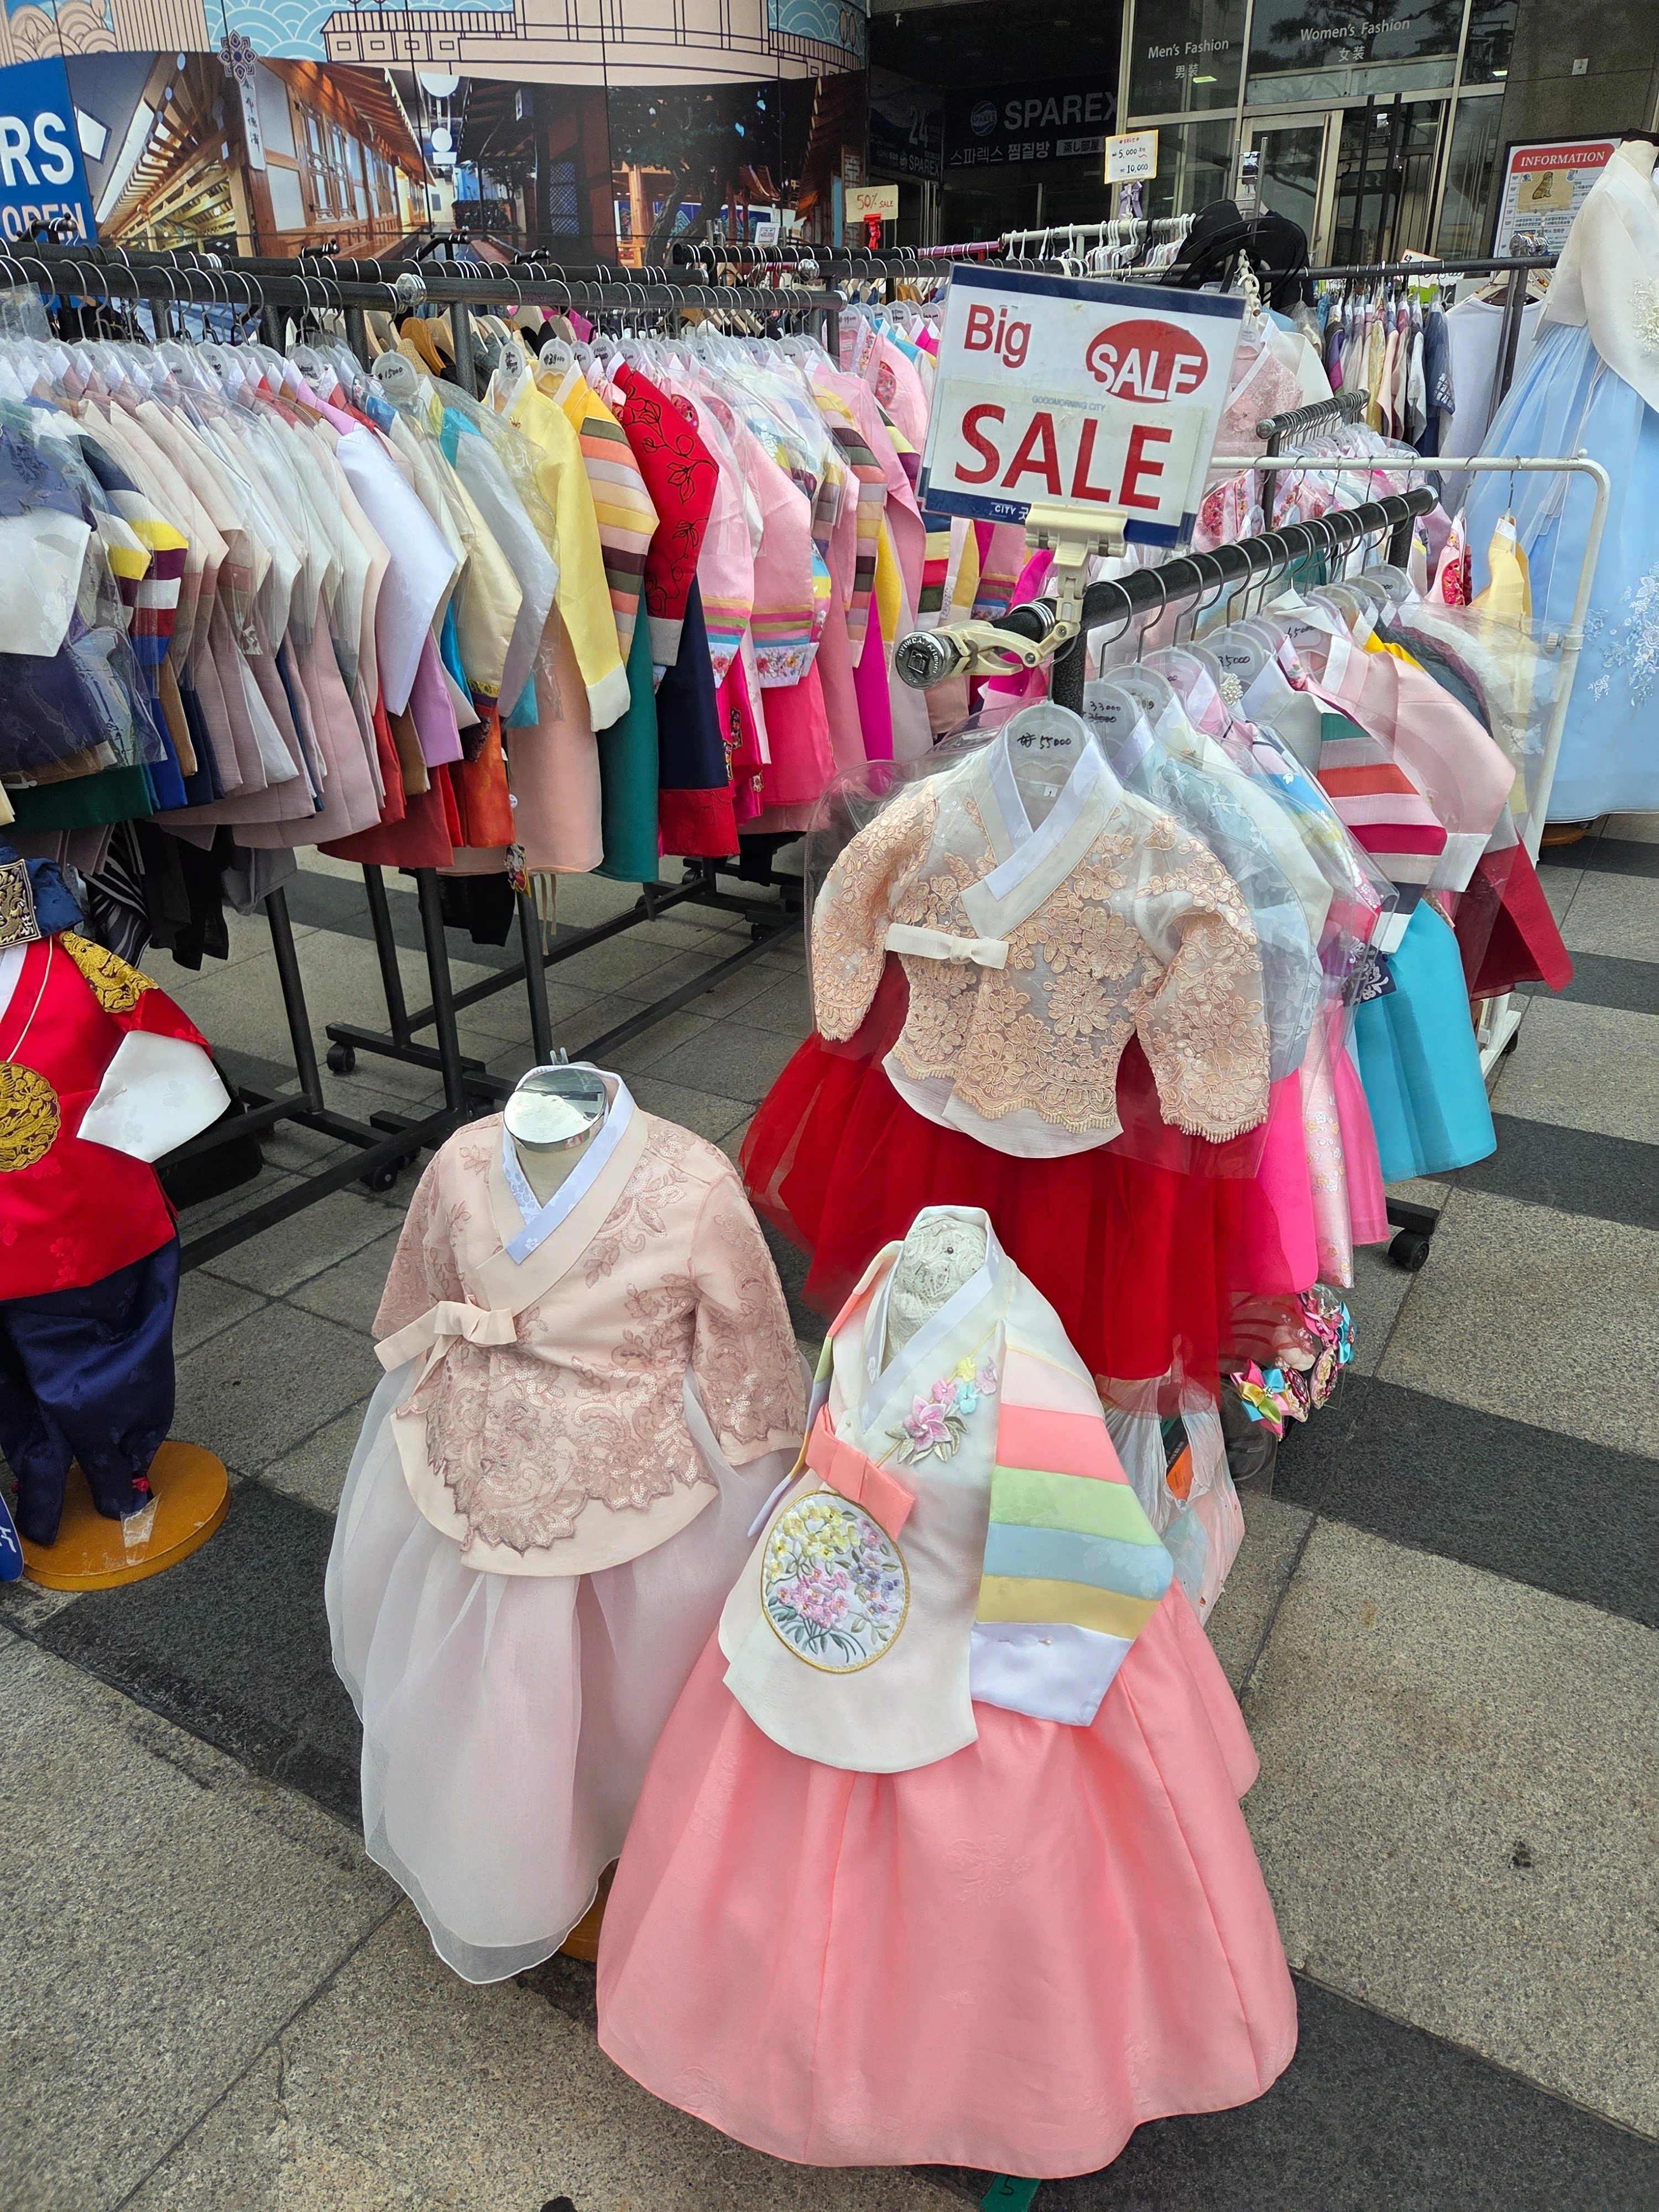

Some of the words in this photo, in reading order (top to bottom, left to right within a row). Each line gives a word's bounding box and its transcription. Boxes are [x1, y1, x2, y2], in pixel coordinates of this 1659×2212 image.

[1301, 23, 1355, 41] Women's
[1361, 19, 1410, 34] Fashion
[1148, 44, 1180, 59] Men's
[1185, 39, 1228, 54] Fashion
[1338, 45, 1365, 62] 女装
[1175, 63, 1199, 79] 男装
[1004, 92, 1118, 130] SPAREX
[0, 112, 74, 186] RS
[950, 145, 1003, 165] 스파렉스
[1008, 141, 1050, 161] 찜질방
[1521, 152, 1605, 166] INFORMATION
[857, 192, 878, 210] 50%
[963, 304, 1031, 368] Big
[1091, 344, 1203, 401] SALE
[1032, 395, 1087, 410] GOODMORNING
[1089, 402, 1106, 411] CITY
[954, 404, 1173, 510] SALE
[995, 504, 1016, 515] CITY
[1090, 701, 1121, 711] 33000
